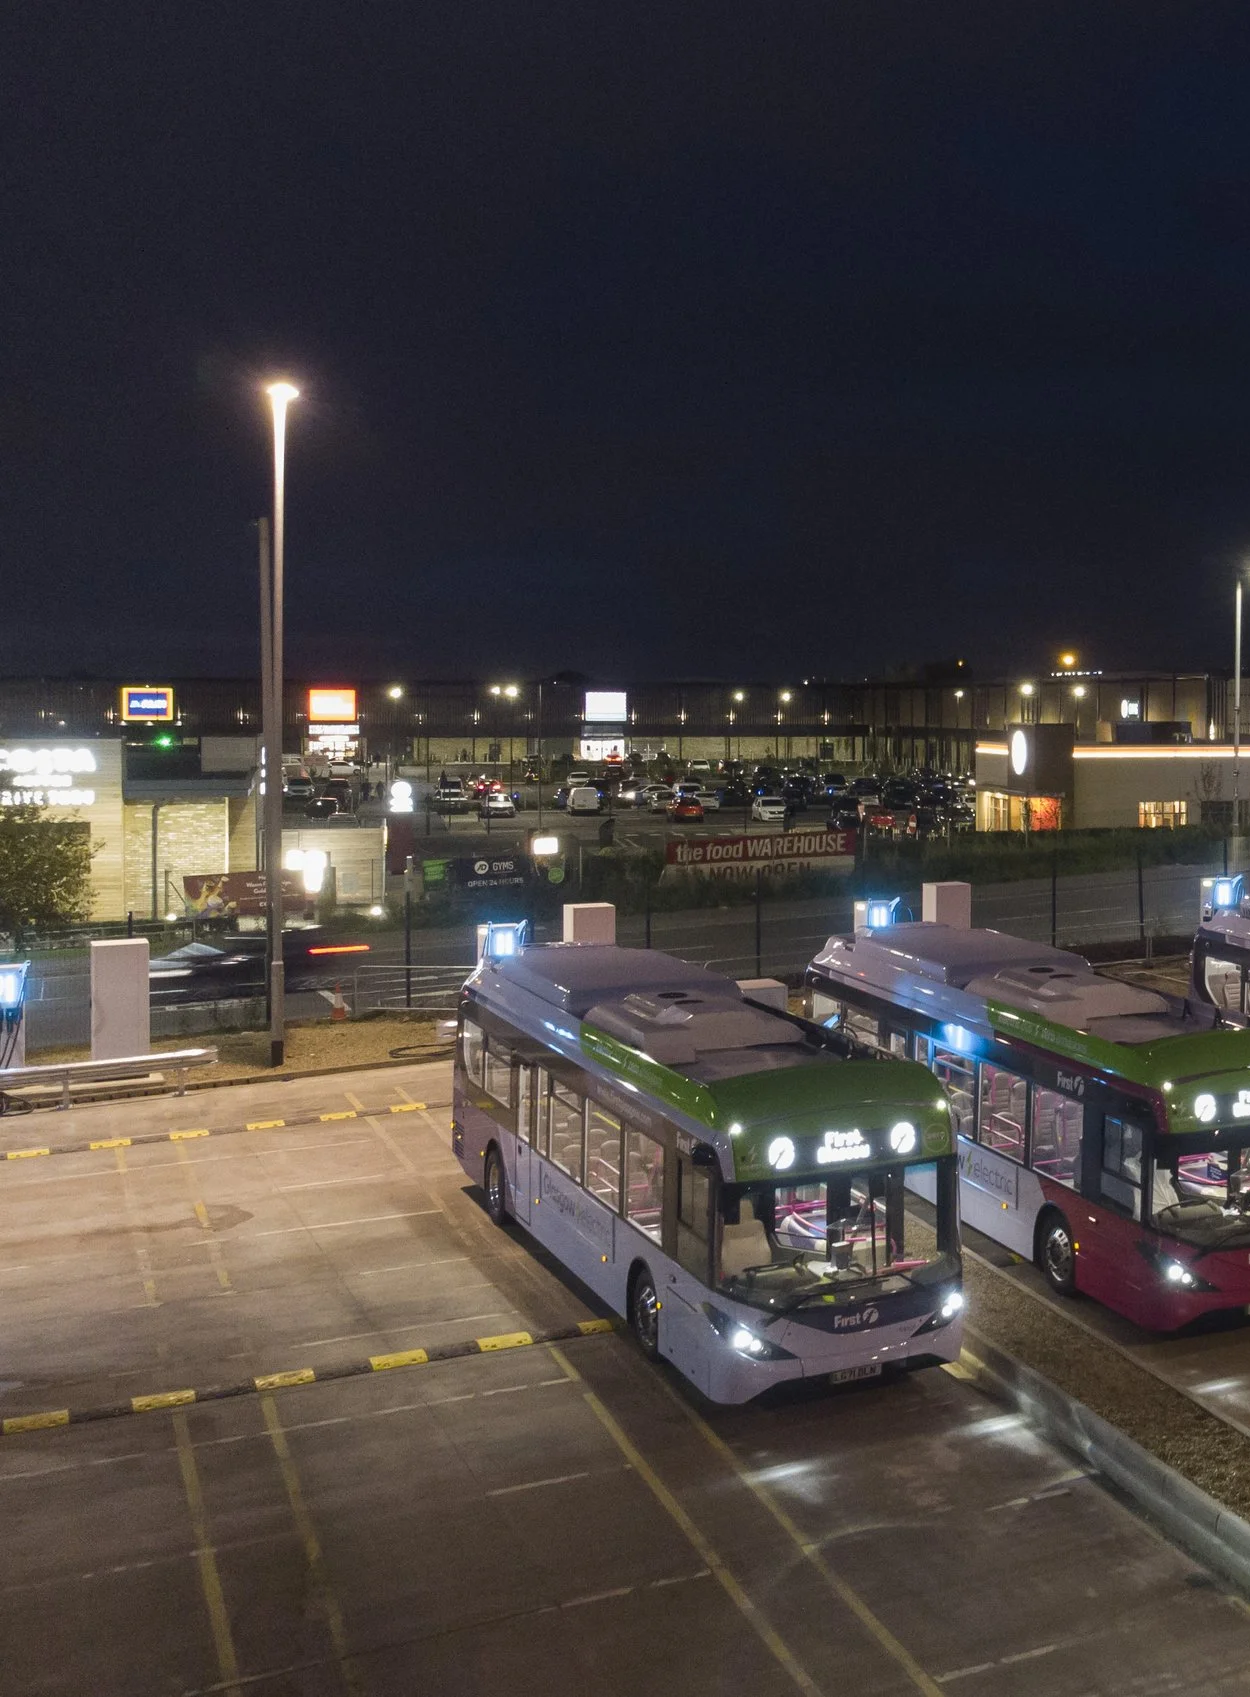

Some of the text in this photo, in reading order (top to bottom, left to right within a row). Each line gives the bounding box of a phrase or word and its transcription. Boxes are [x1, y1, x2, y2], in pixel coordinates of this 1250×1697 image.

[675, 833, 848, 863] the food WAREHOUSE
[492, 861, 514, 871] GYMS
[467, 876, 524, 888] OPEN 24 HOURS
[1056, 1070, 1074, 1091] First
[973, 1157, 1014, 1196] electric
[833, 1312, 862, 1329] First
